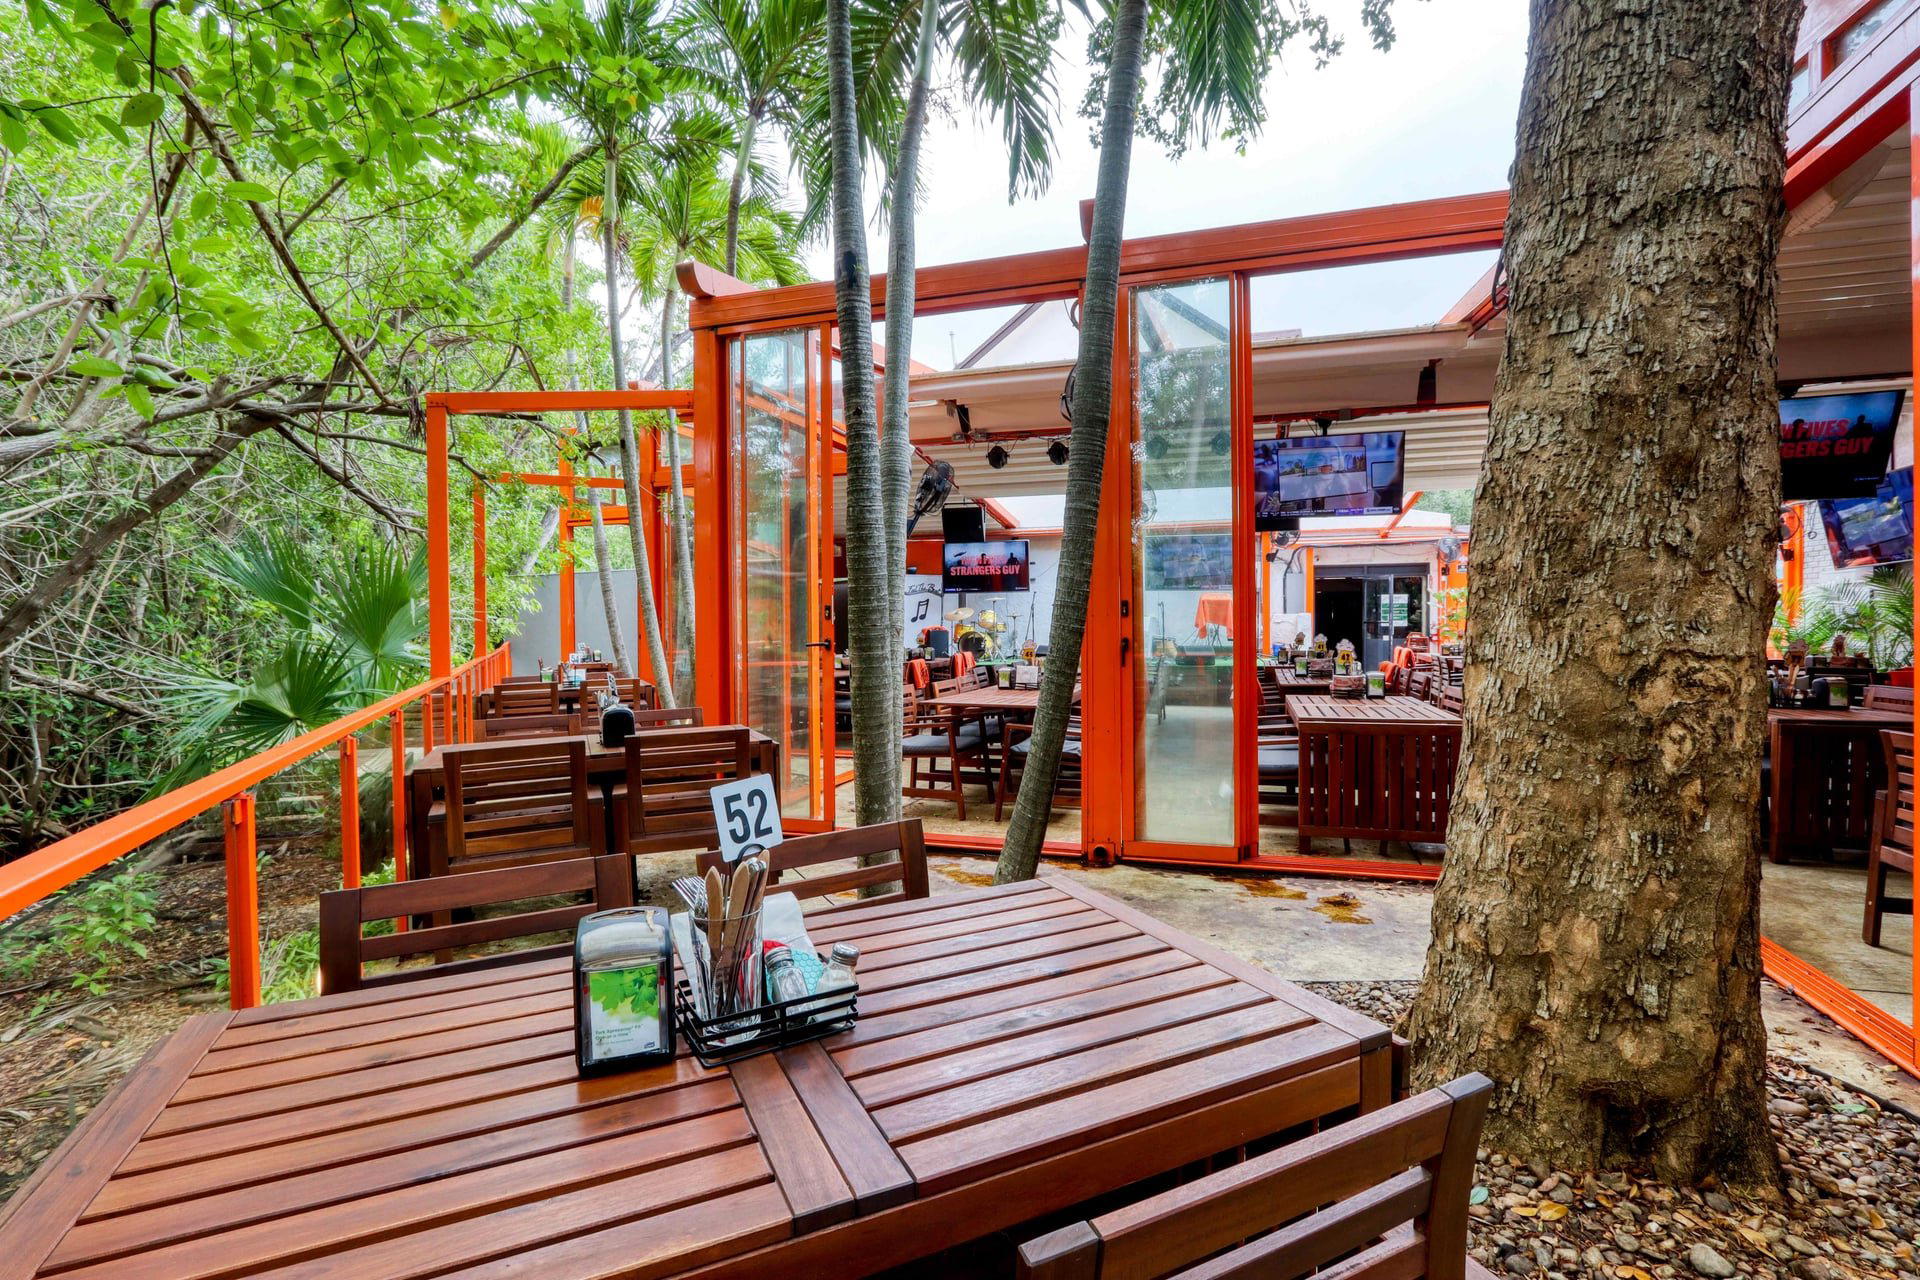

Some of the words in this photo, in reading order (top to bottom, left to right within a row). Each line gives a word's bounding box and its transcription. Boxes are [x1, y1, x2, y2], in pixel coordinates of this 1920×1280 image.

[1780, 440, 1831, 458] GERS
[1833, 437, 1873, 456] GUY
[950, 565, 1001, 576] STRANGERS
[1002, 564, 1021, 575] GUY
[723, 788, 773, 844] 52
